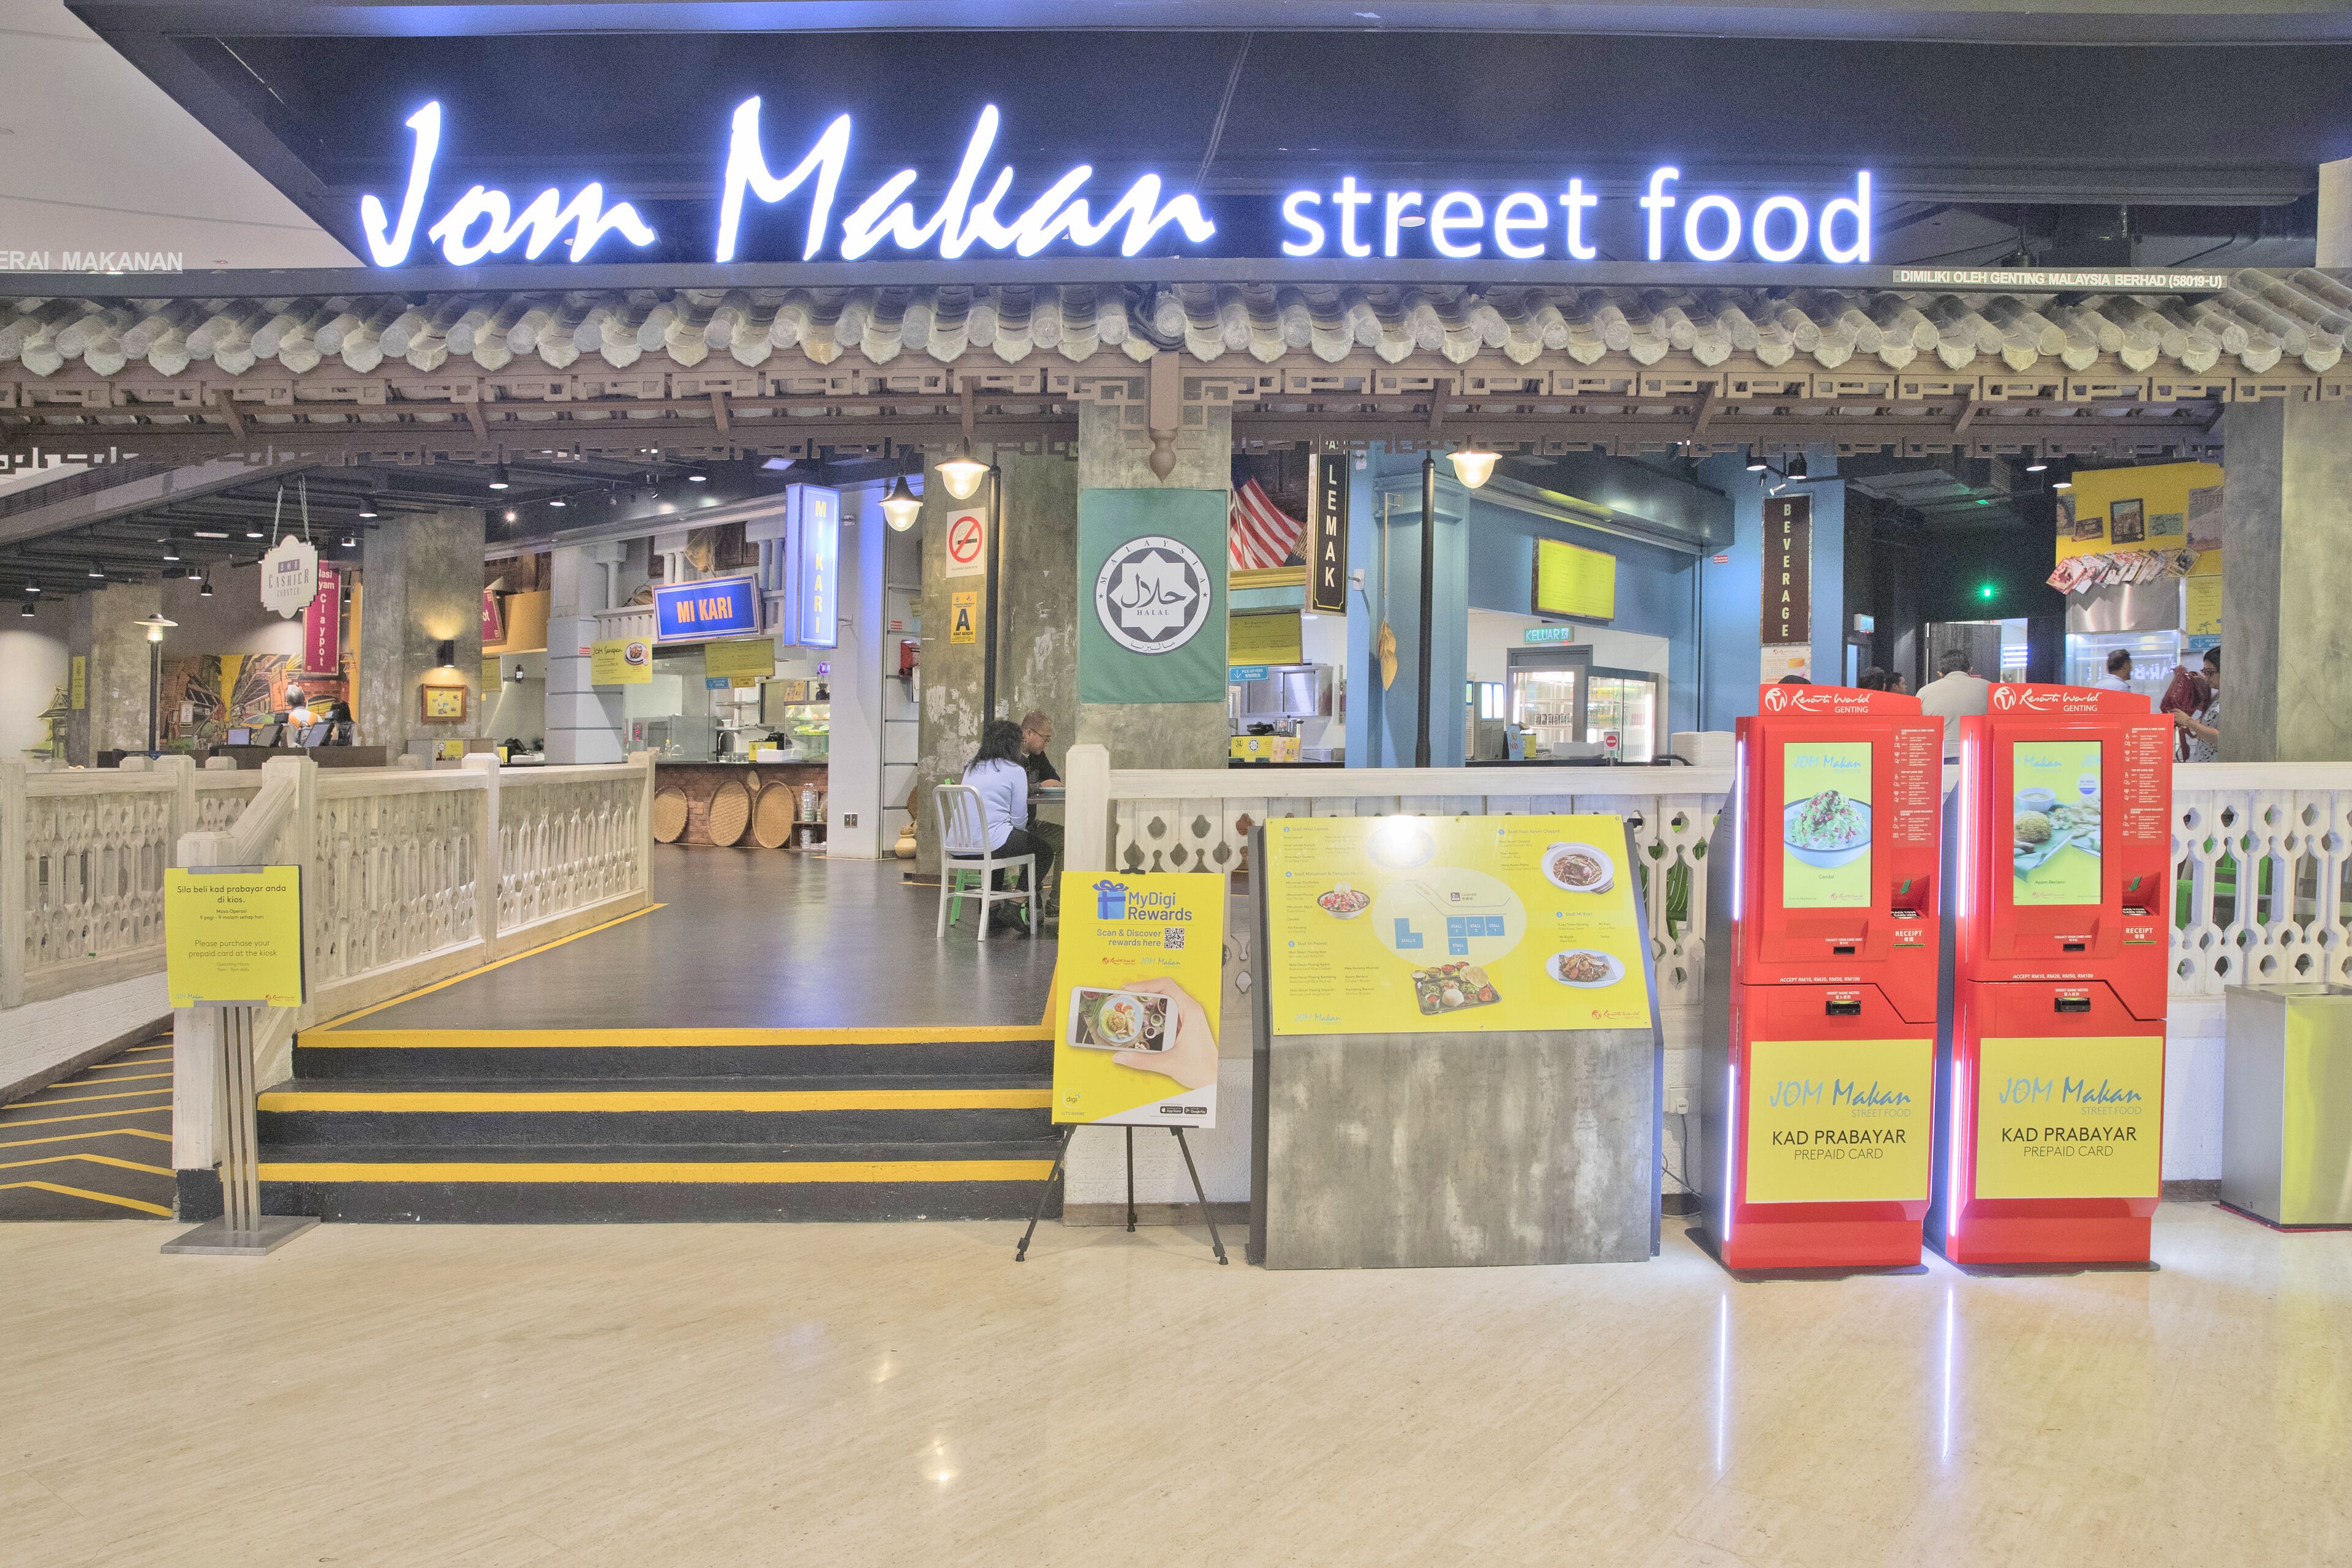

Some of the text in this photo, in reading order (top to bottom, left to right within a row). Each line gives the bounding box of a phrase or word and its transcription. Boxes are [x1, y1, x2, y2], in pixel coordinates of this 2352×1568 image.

[361, 96, 1215, 268] Jom Makan
[1282, 167, 1871, 262] street food
[62, 251, 183, 271] MAKANAN
[1901, 271, 2223, 288] DIMILIKI OLEH GENTING MALAYSIA BERHAD (58019-U)
[1325, 464, 1337, 588] LEMAK
[814, 500, 826, 633] MI KARI
[1100, 540, 1205, 584] MALAYSIA
[1782, 503, 1791, 637] BEVERAGE
[268, 568, 309, 589] CASHIER
[318, 569, 333, 579] asi
[1121, 573, 1186, 608] حلال
[676, 596, 733, 623] MI KARI
[956, 608, 970, 631] A
[1526, 628, 1559, 641] KELUAR
[1834, 693, 1869, 703] World
[2063, 692, 2100, 702] World
[1823, 755, 1861, 768] Makan
[227, 885, 263, 894] prabayar
[1128, 892, 1176, 909] MyDigi
[1128, 907, 1192, 921] Rewards
[1770, 1079, 1911, 1107] JOM Makan
[1999, 1076, 2142, 1104] JOM Makan
[1852, 1109, 1882, 1117] STREET
[2081, 1107, 2112, 1115] STREET
[1773, 1129, 1906, 1145] KAD PRABAYAR
[2002, 1127, 2137, 1142] KAD PRABAYAR
[1795, 1148, 1883, 1160] PREPAID CARD
[2024, 1145, 2114, 1157] PREPAID CARD
